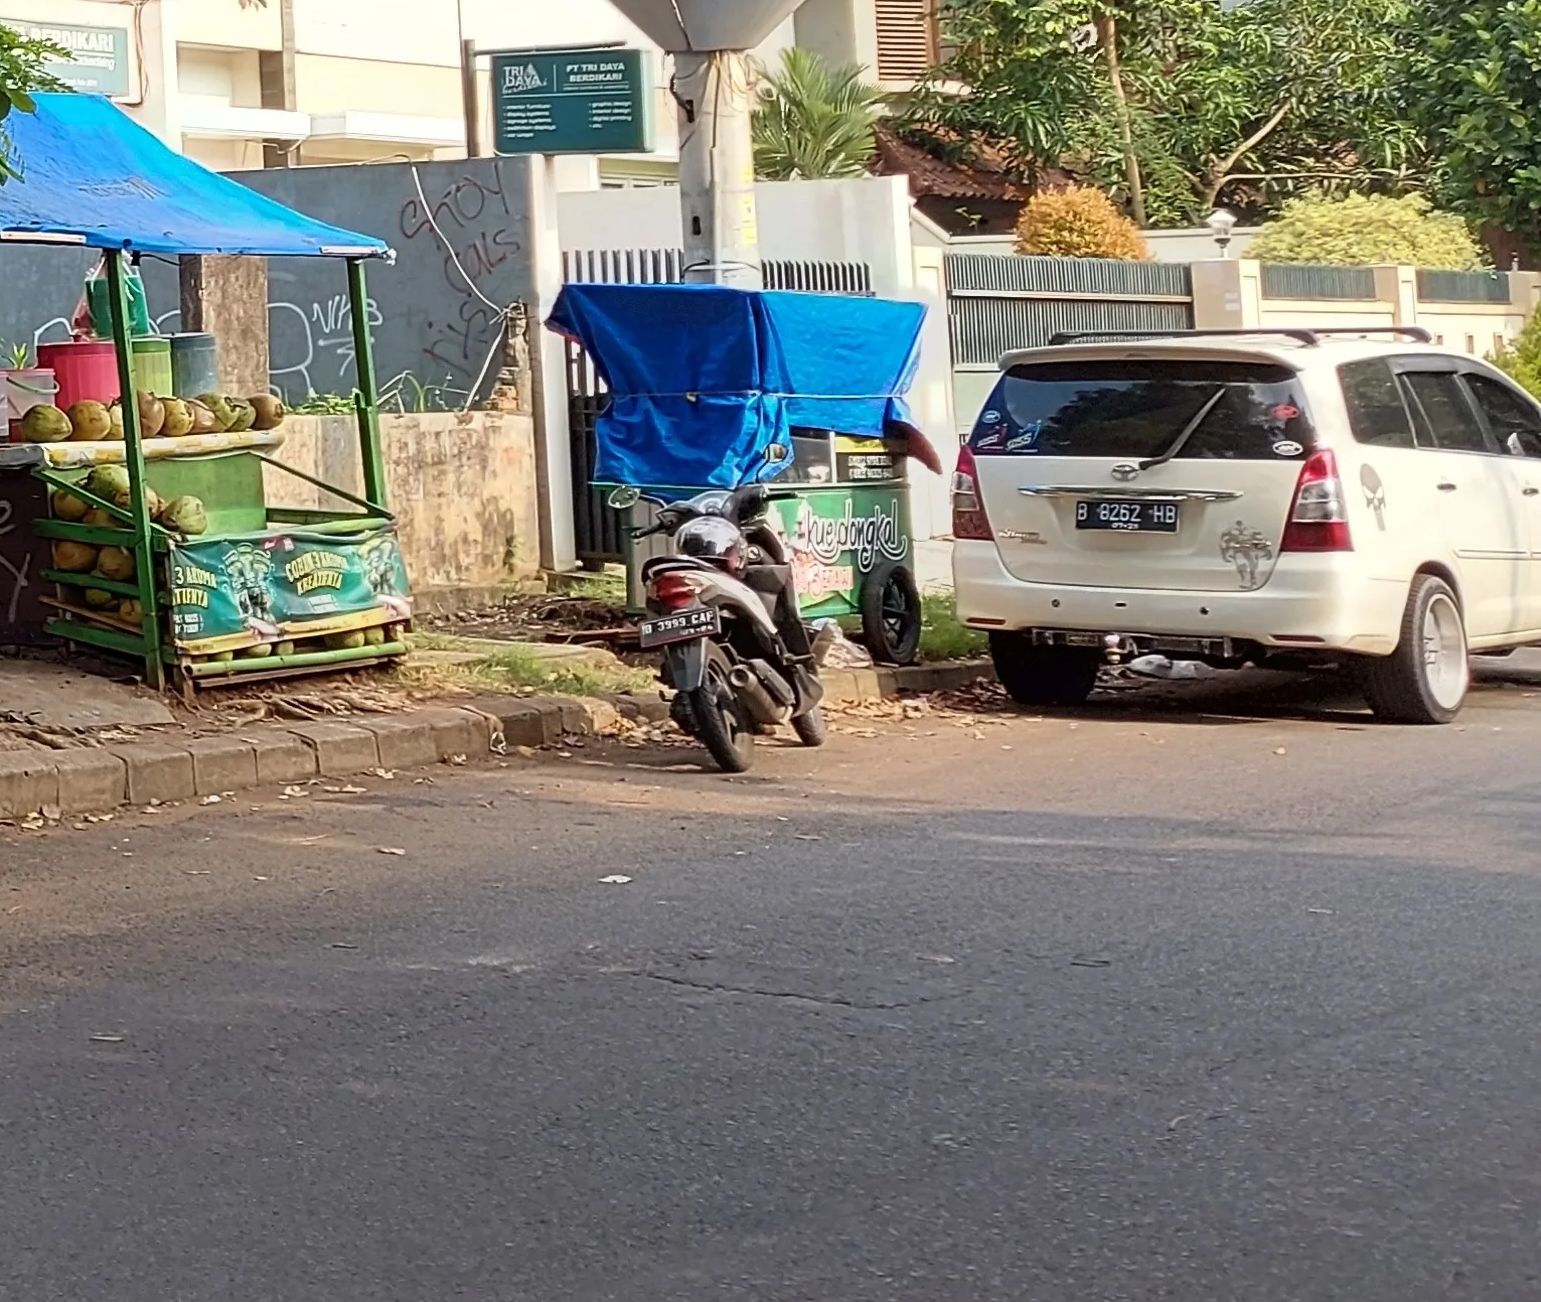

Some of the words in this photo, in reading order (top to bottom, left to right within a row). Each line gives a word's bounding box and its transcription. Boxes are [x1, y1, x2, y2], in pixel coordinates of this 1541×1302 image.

[503, 66, 524, 77] TRI
[566, 65, 580, 73] PT
[582, 64, 598, 72] TRI
[600, 62, 626, 71] DAYA
[506, 75, 542, 86] DAYA
[570, 73, 623, 83] BERDIKARI
[1077, 503, 1088, 520] B
[1099, 503, 1141, 522] 8262
[1153, 505, 1176, 523] HB
[836, 498, 907, 573] dongkal
[174, 566, 184, 585] 3
[657, 617, 686, 632] 3999
